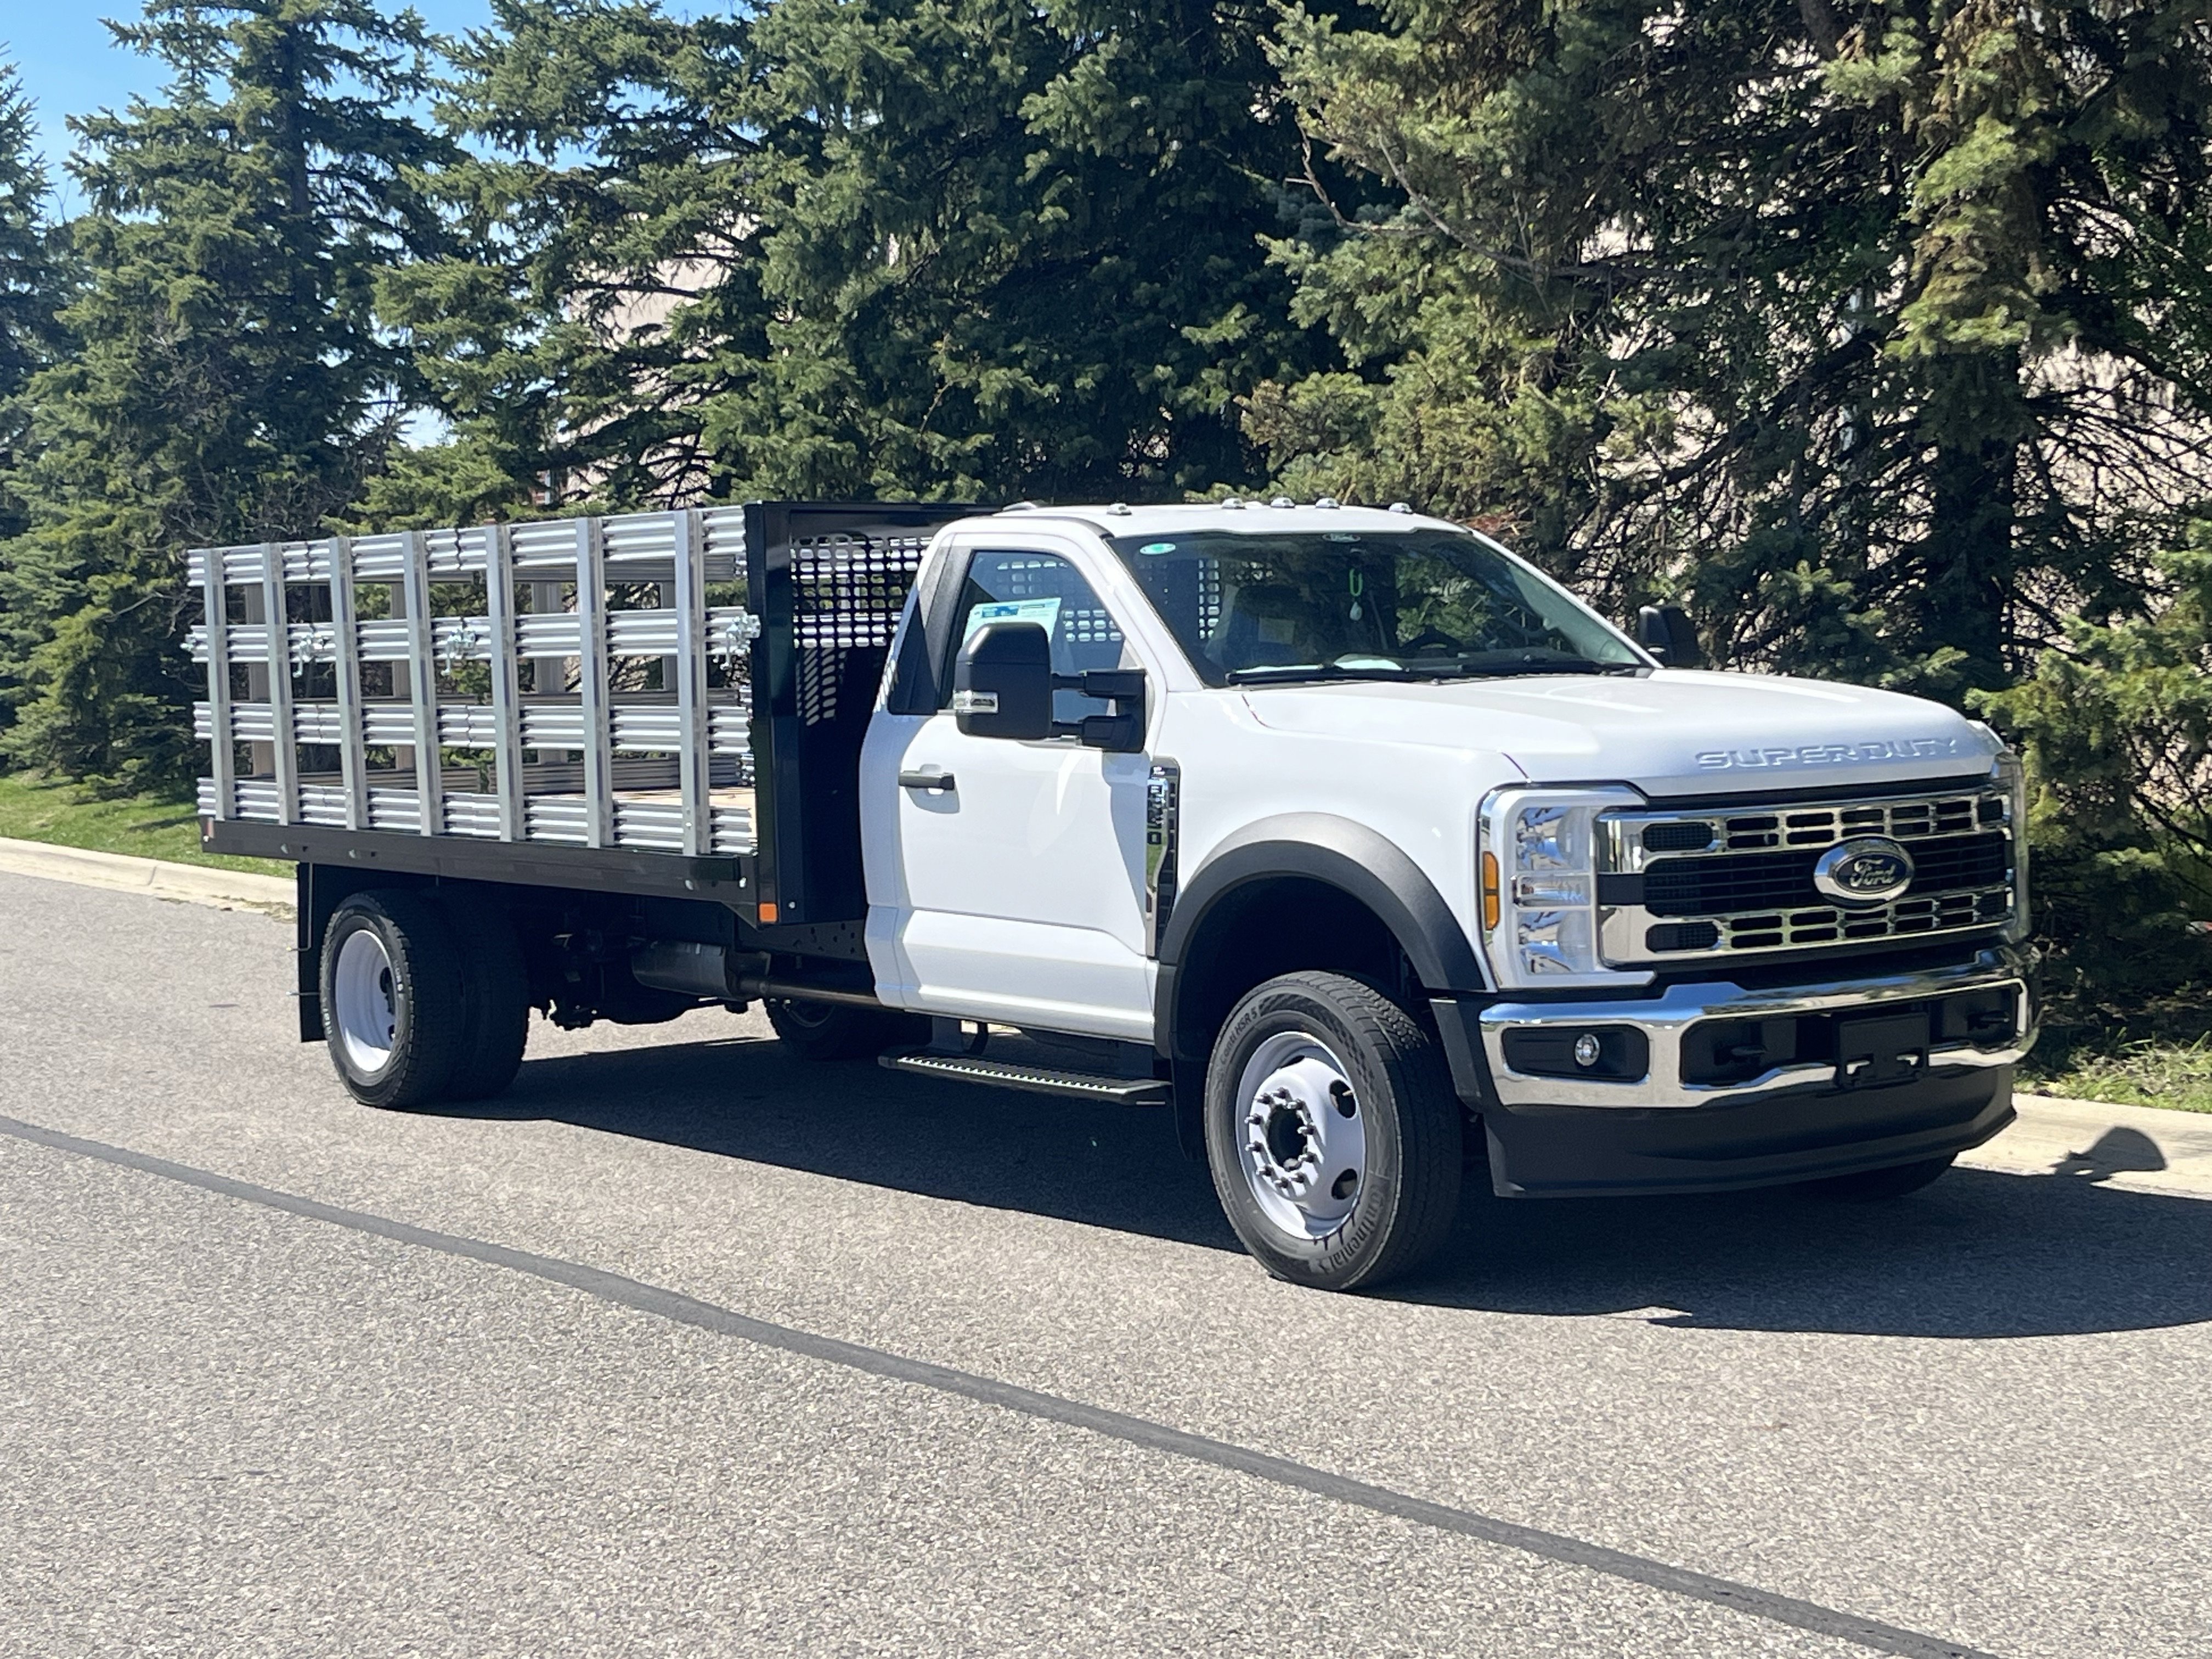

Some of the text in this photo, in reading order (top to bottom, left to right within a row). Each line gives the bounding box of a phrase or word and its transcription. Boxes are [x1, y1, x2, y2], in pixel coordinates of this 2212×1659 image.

[1695, 737, 1957, 769] SUPER DUTY
[1849, 859, 1897, 887] Ford
[1219, 1006, 1258, 1065] Conti HSR 5
[1328, 1183, 1385, 1271] Continental
